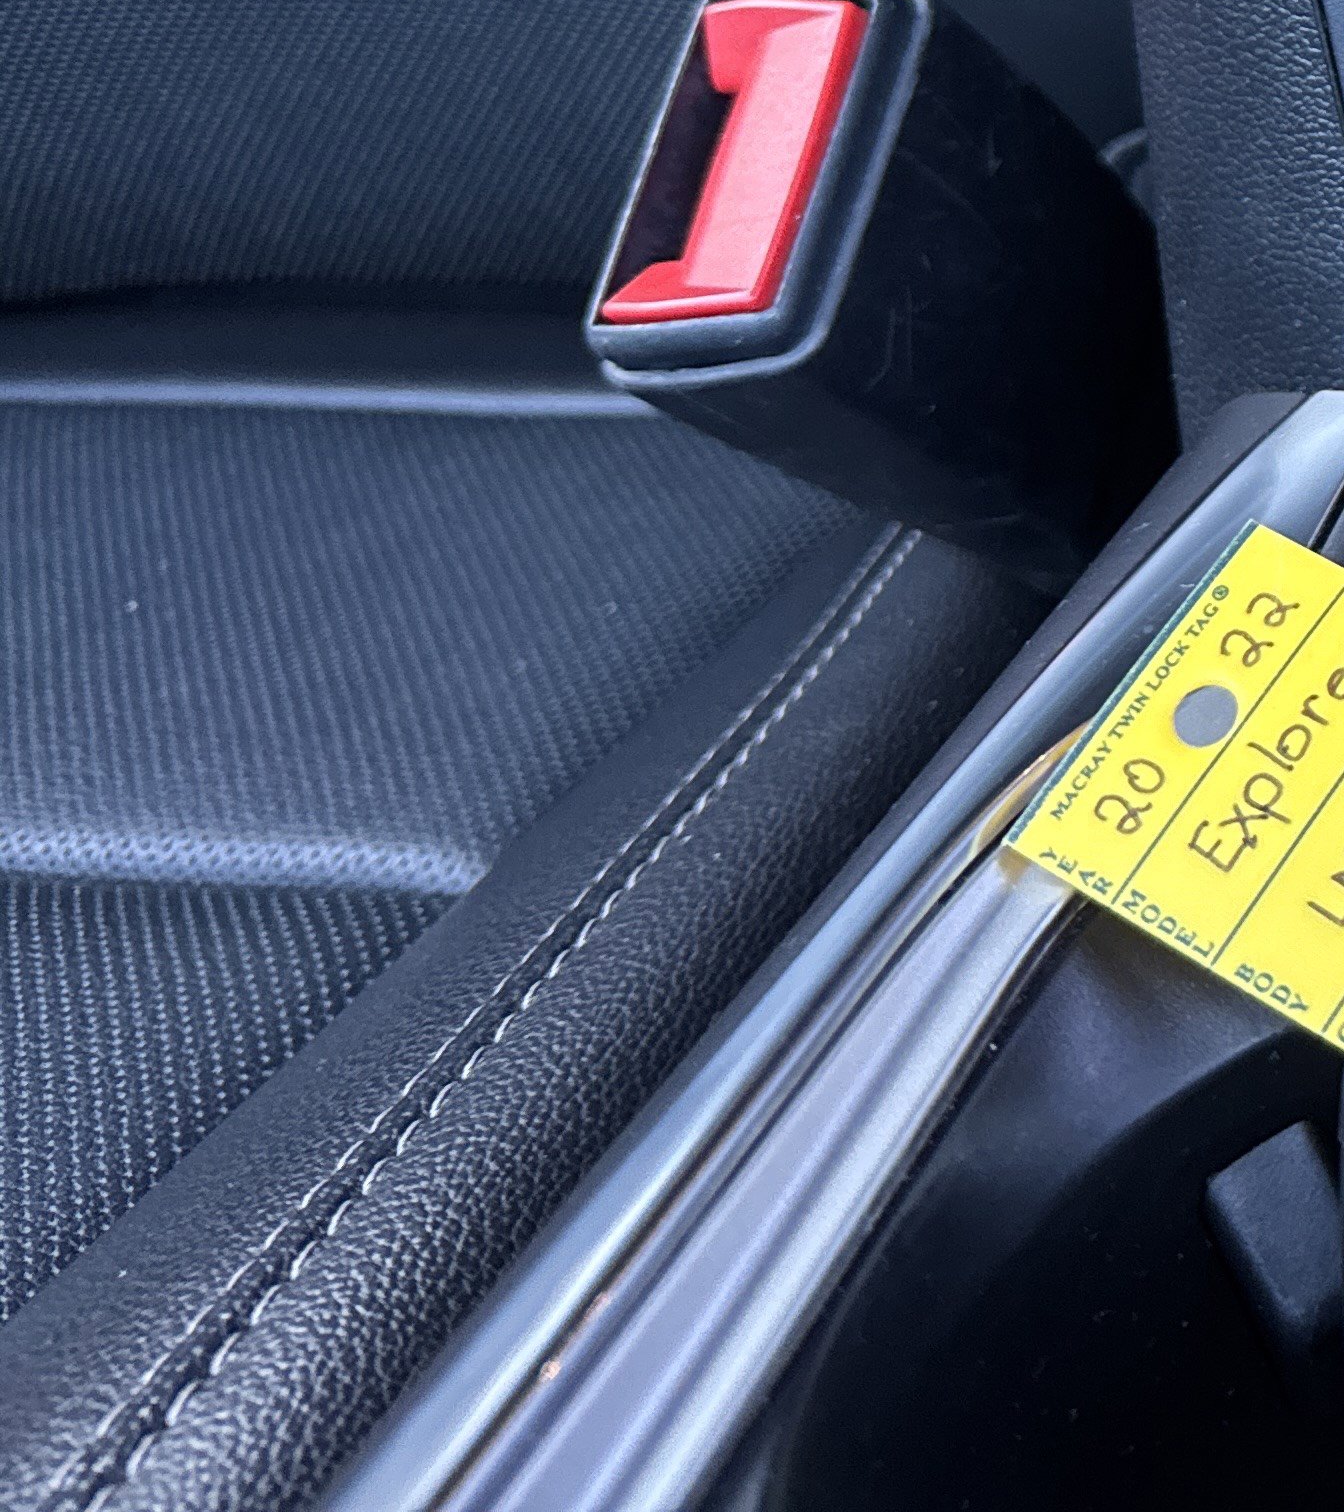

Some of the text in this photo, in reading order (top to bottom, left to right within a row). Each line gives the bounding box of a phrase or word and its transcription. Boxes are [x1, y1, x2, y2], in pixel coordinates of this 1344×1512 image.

[1050, 740, 1113, 821] MACRAY
[1108, 691, 1151, 743] TWIN
[1145, 640, 1191, 693] LOCK
[1094, 591, 1301, 835] 20 22
[1039, 847, 1114, 896] YEAR
[1121, 888, 1215, 959] MODEL
[1233, 962, 1311, 1013] BODY
